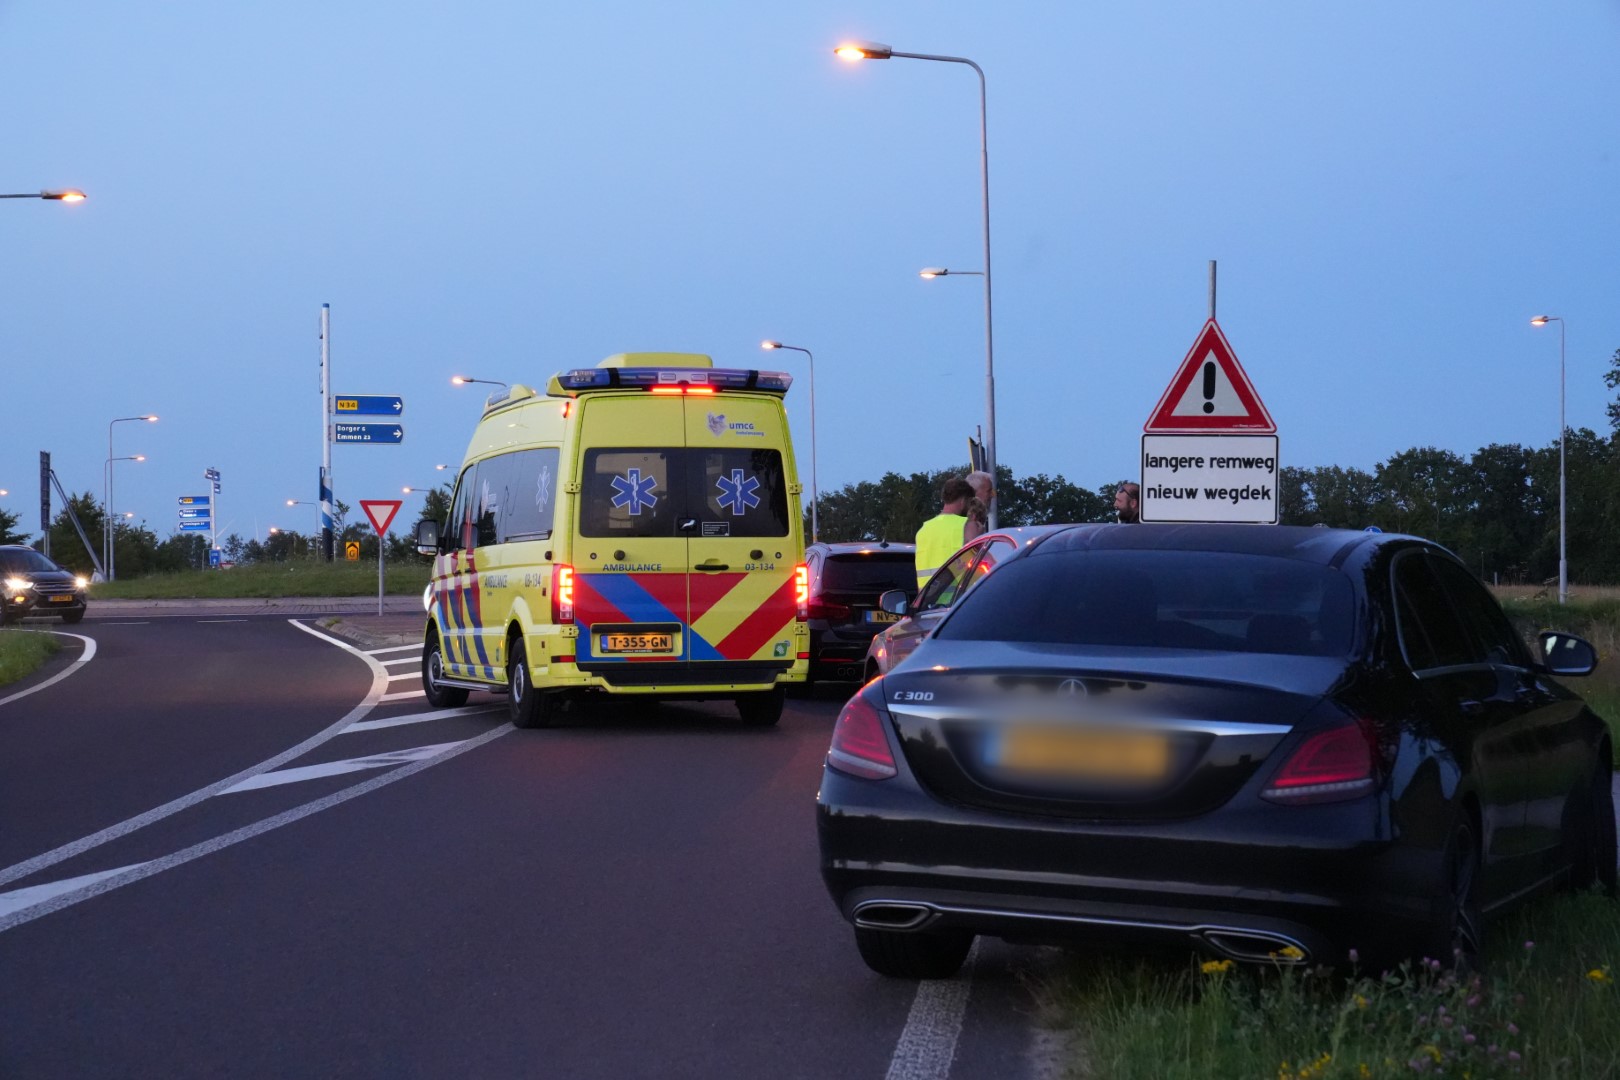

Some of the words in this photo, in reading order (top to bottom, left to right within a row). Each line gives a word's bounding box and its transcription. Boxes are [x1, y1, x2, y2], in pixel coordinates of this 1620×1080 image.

[1145, 453, 1205, 473] langere
[1209, 456, 1275, 474] remweg
[1146, 484, 1199, 499] nieuw
[1204, 484, 1271, 504] wegdek
[602, 563, 662, 571] AMBULANCE
[745, 563, 774, 571] 03-134
[611, 636, 668, 648] T-355-GN
[894, 691, 904, 700] C
[905, 691, 934, 701] 300
